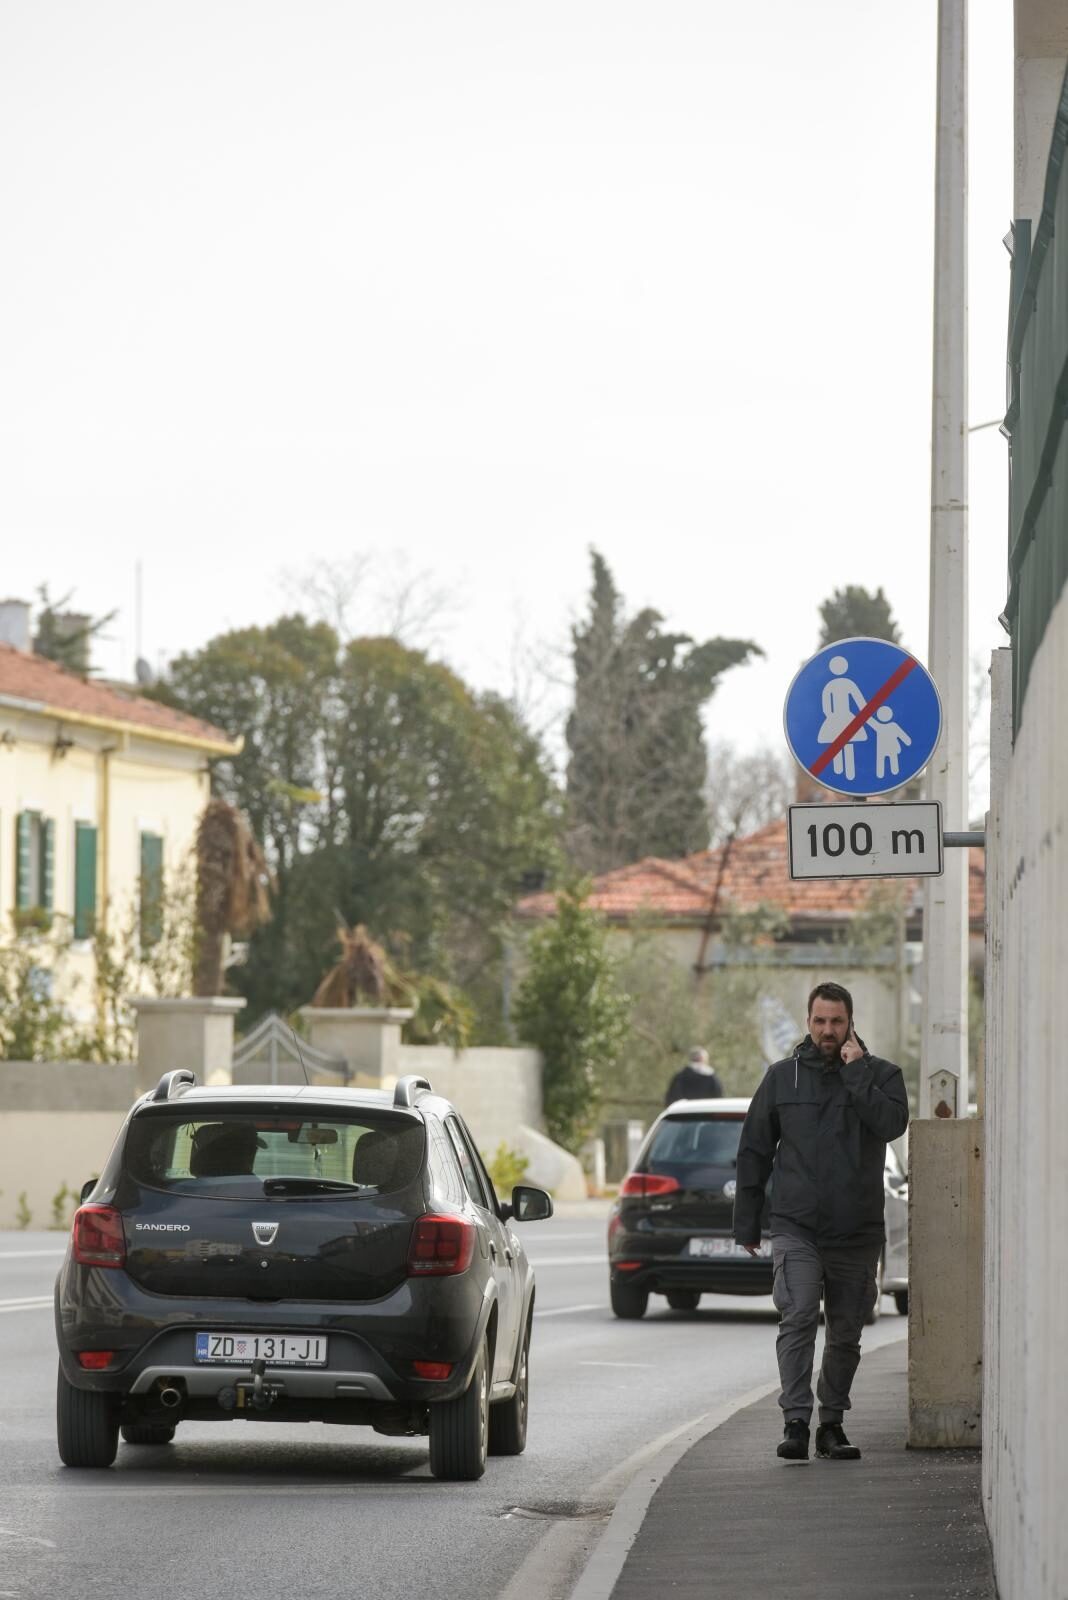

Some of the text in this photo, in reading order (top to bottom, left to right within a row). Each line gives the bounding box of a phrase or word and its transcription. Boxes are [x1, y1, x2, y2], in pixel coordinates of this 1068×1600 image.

[807, 822, 925, 857] 100 m
[135, 1223, 191, 1232] SANDERO
[210, 1336, 320, 1360] ZD 131-JI
